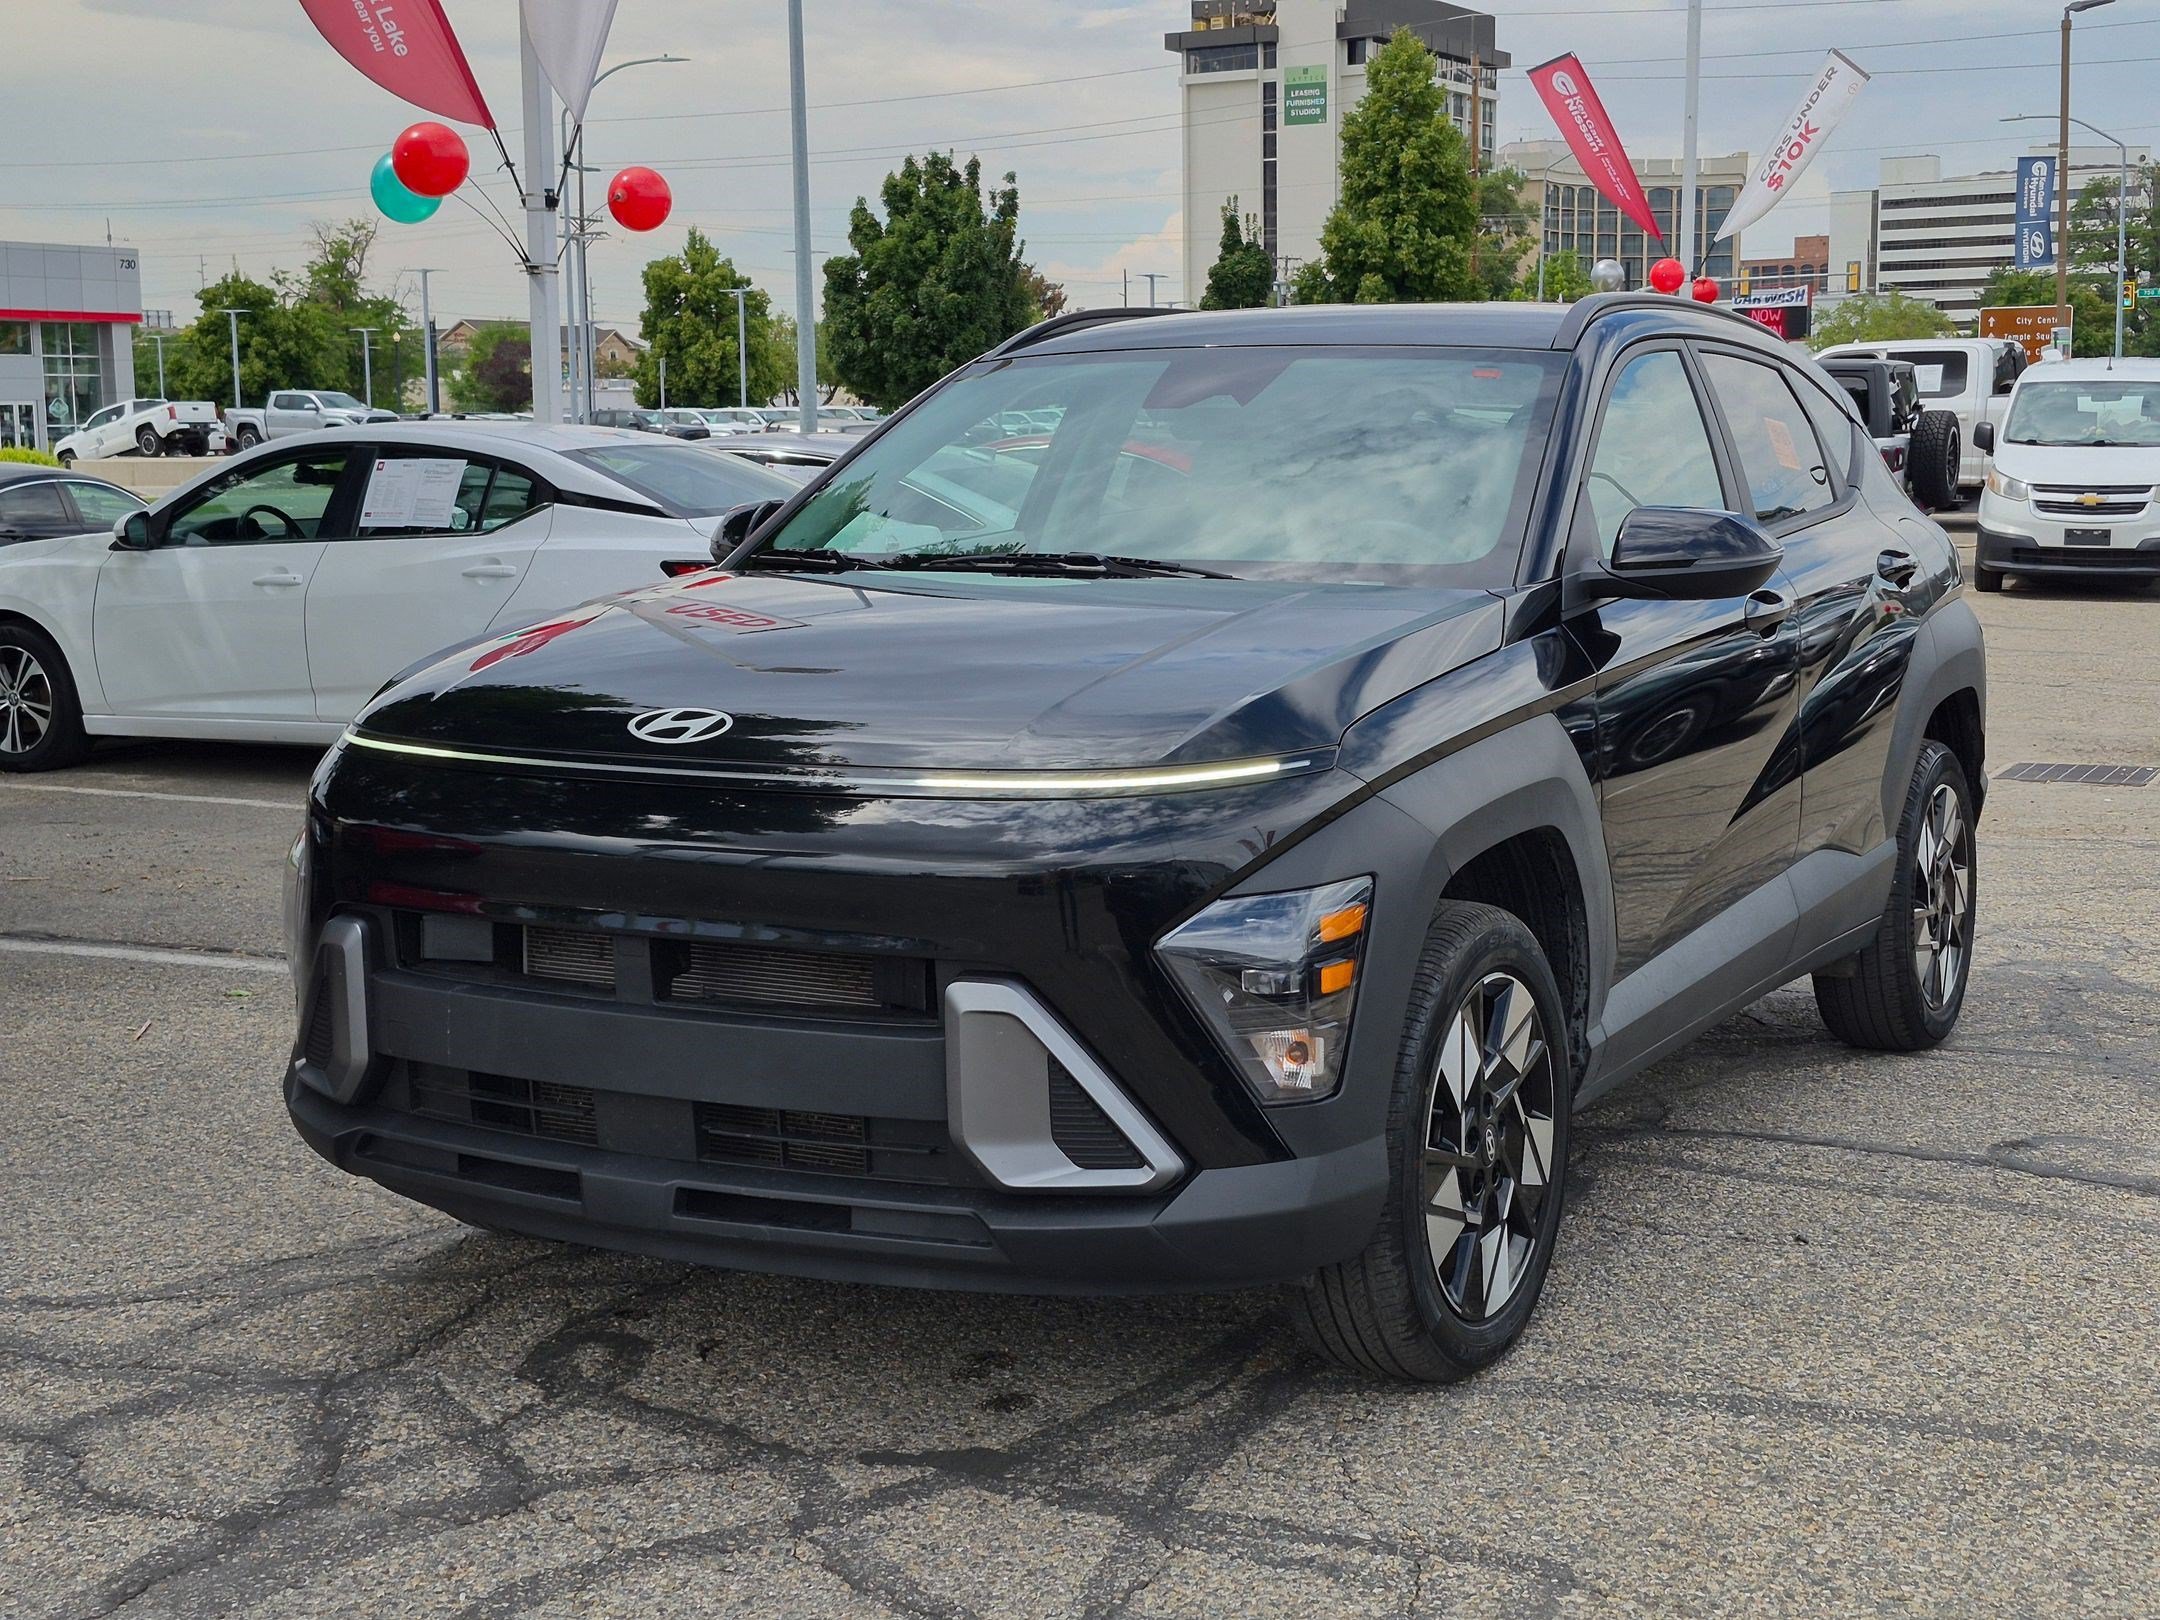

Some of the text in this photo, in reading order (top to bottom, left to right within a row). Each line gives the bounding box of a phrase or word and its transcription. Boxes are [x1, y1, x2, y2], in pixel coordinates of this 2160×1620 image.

[354, 0, 372, 24] ear
[363, 22, 385, 52] you
[376, 6, 408, 57] Lake
[1291, 89, 1320, 97] LEASING
[1286, 98, 1326, 107] FURNISHED
[1573, 95, 1588, 119] Ken
[1290, 108, 1320, 116] STUDIOS
[1564, 98, 1601, 152] Nissan
[1760, 66, 1838, 182] CARS UNDER
[1767, 119, 1821, 192] $10K
[2038, 177, 2046, 190] Ken
[2028, 177, 2038, 217] Hyundai
[119, 259, 136, 270] 730
[1764, 288, 1806, 304] WASH
[1751, 309, 1782, 322] NOW
[2016, 316, 2058, 325] City Cent
[2004, 332, 2051, 342] Temple Squ
[665, 603, 777, 627] USED
